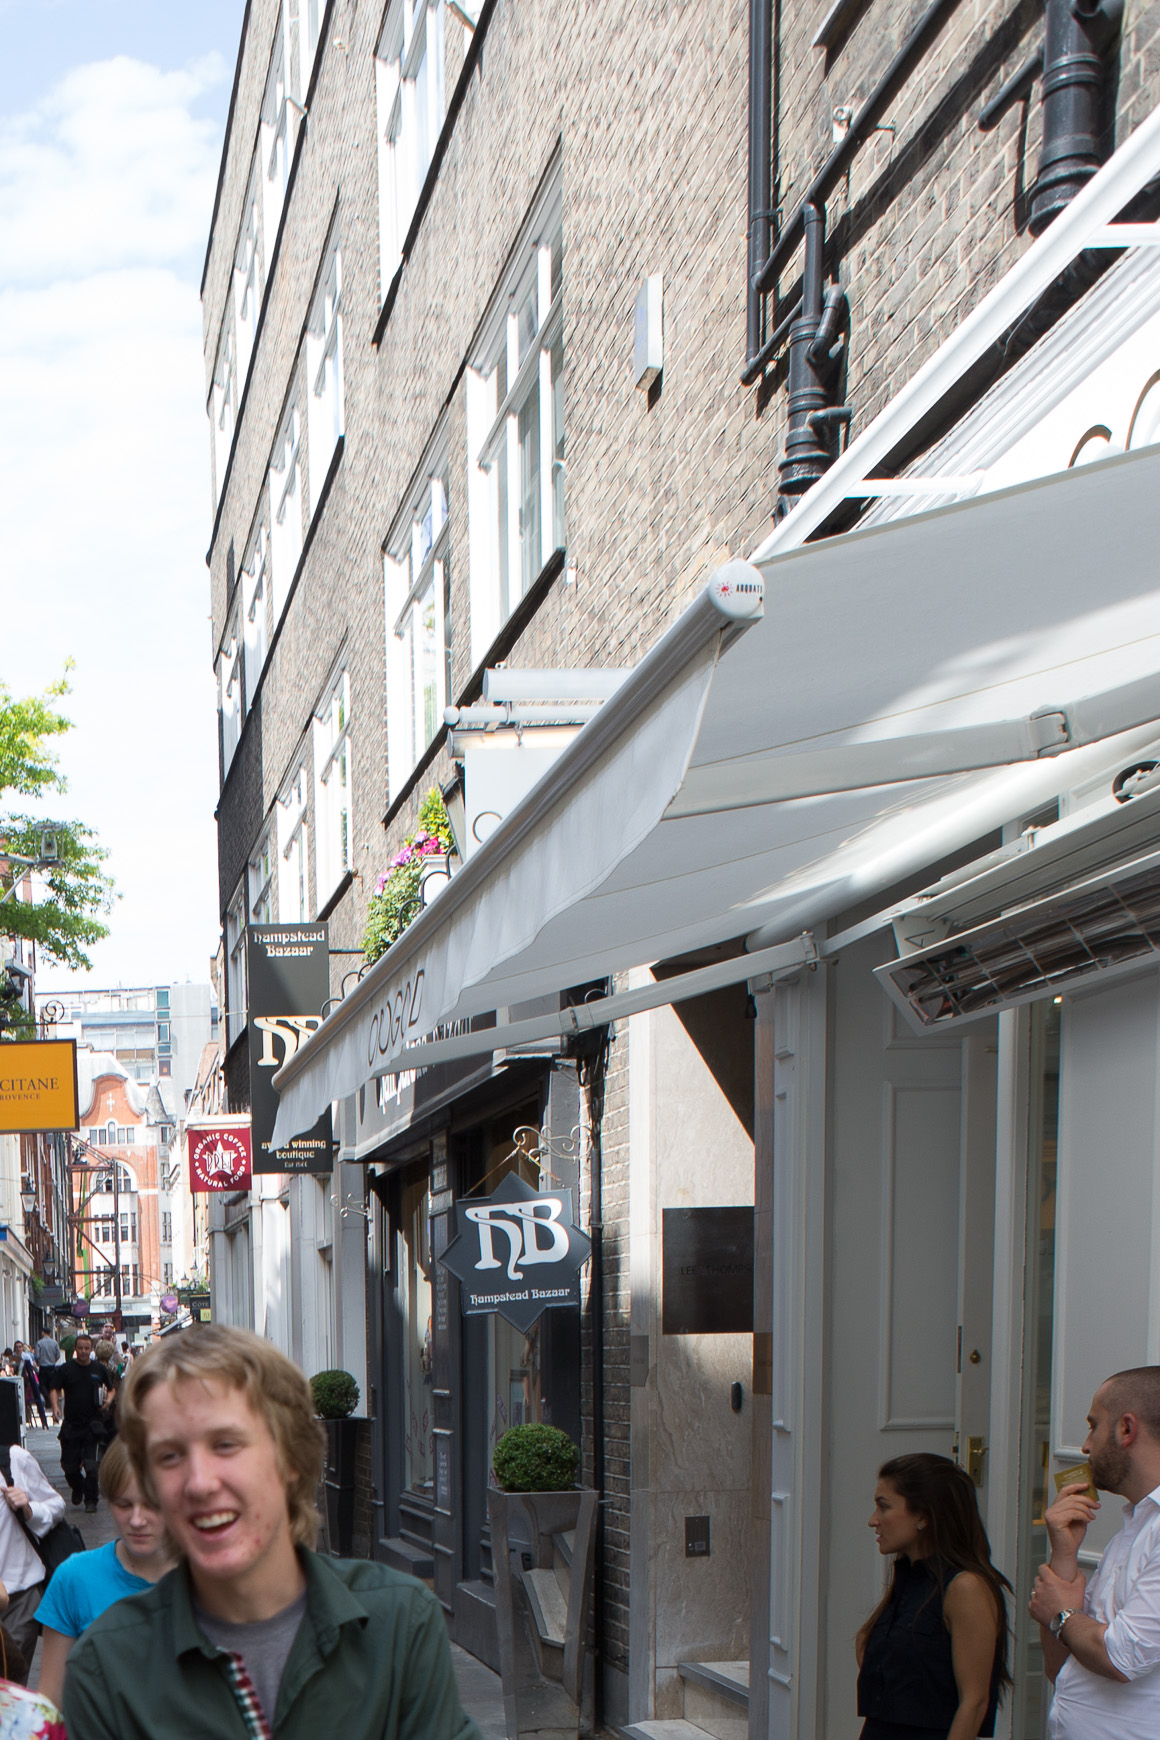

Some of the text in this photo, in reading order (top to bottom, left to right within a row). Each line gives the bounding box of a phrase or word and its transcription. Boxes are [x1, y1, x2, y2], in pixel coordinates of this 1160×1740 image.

[253, 929, 325, 945] Hampstead
[265, 944, 314, 958] Bazaar
[193, 1132, 247, 1160] ORGANIC COFFEE
[291, 1139, 327, 1150] winning
[276, 1150, 315, 1160] boutique
[195, 1165, 246, 1188] NATURAL FOOD
[680, 1265, 697, 1276] LEE
[470, 1287, 570, 1306] Hampstead Bazaar
